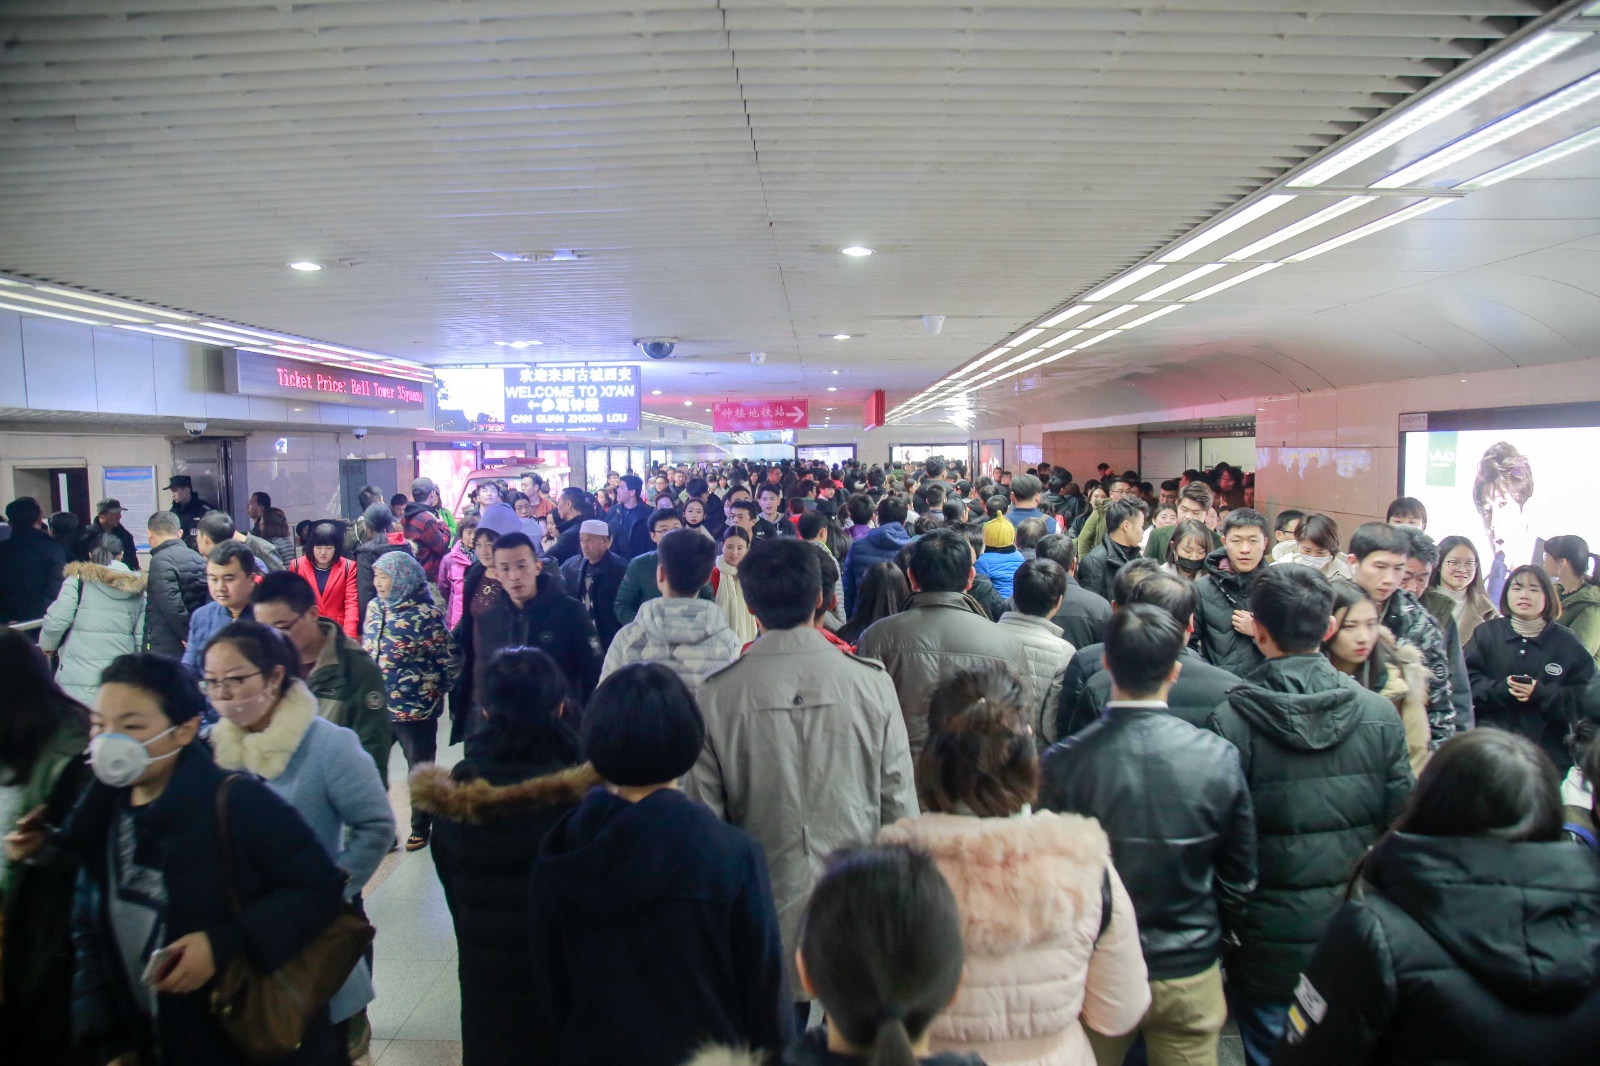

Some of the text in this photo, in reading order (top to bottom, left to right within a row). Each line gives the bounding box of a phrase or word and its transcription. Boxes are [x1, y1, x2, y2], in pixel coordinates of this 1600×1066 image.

[520, 367, 632, 383] 欢迎来到古城西安
[277, 368, 312, 389] Ticket
[316, 374, 347, 393] Price:
[351, 379, 370, 396] Bell
[373, 383, 395, 399] Tower
[505, 384, 634, 398] WELCOME TO XI'AN
[511, 413, 628, 424] CAN GUAN ZHONG LOU
[720, 405, 785, 419] 钟楼地铁站
